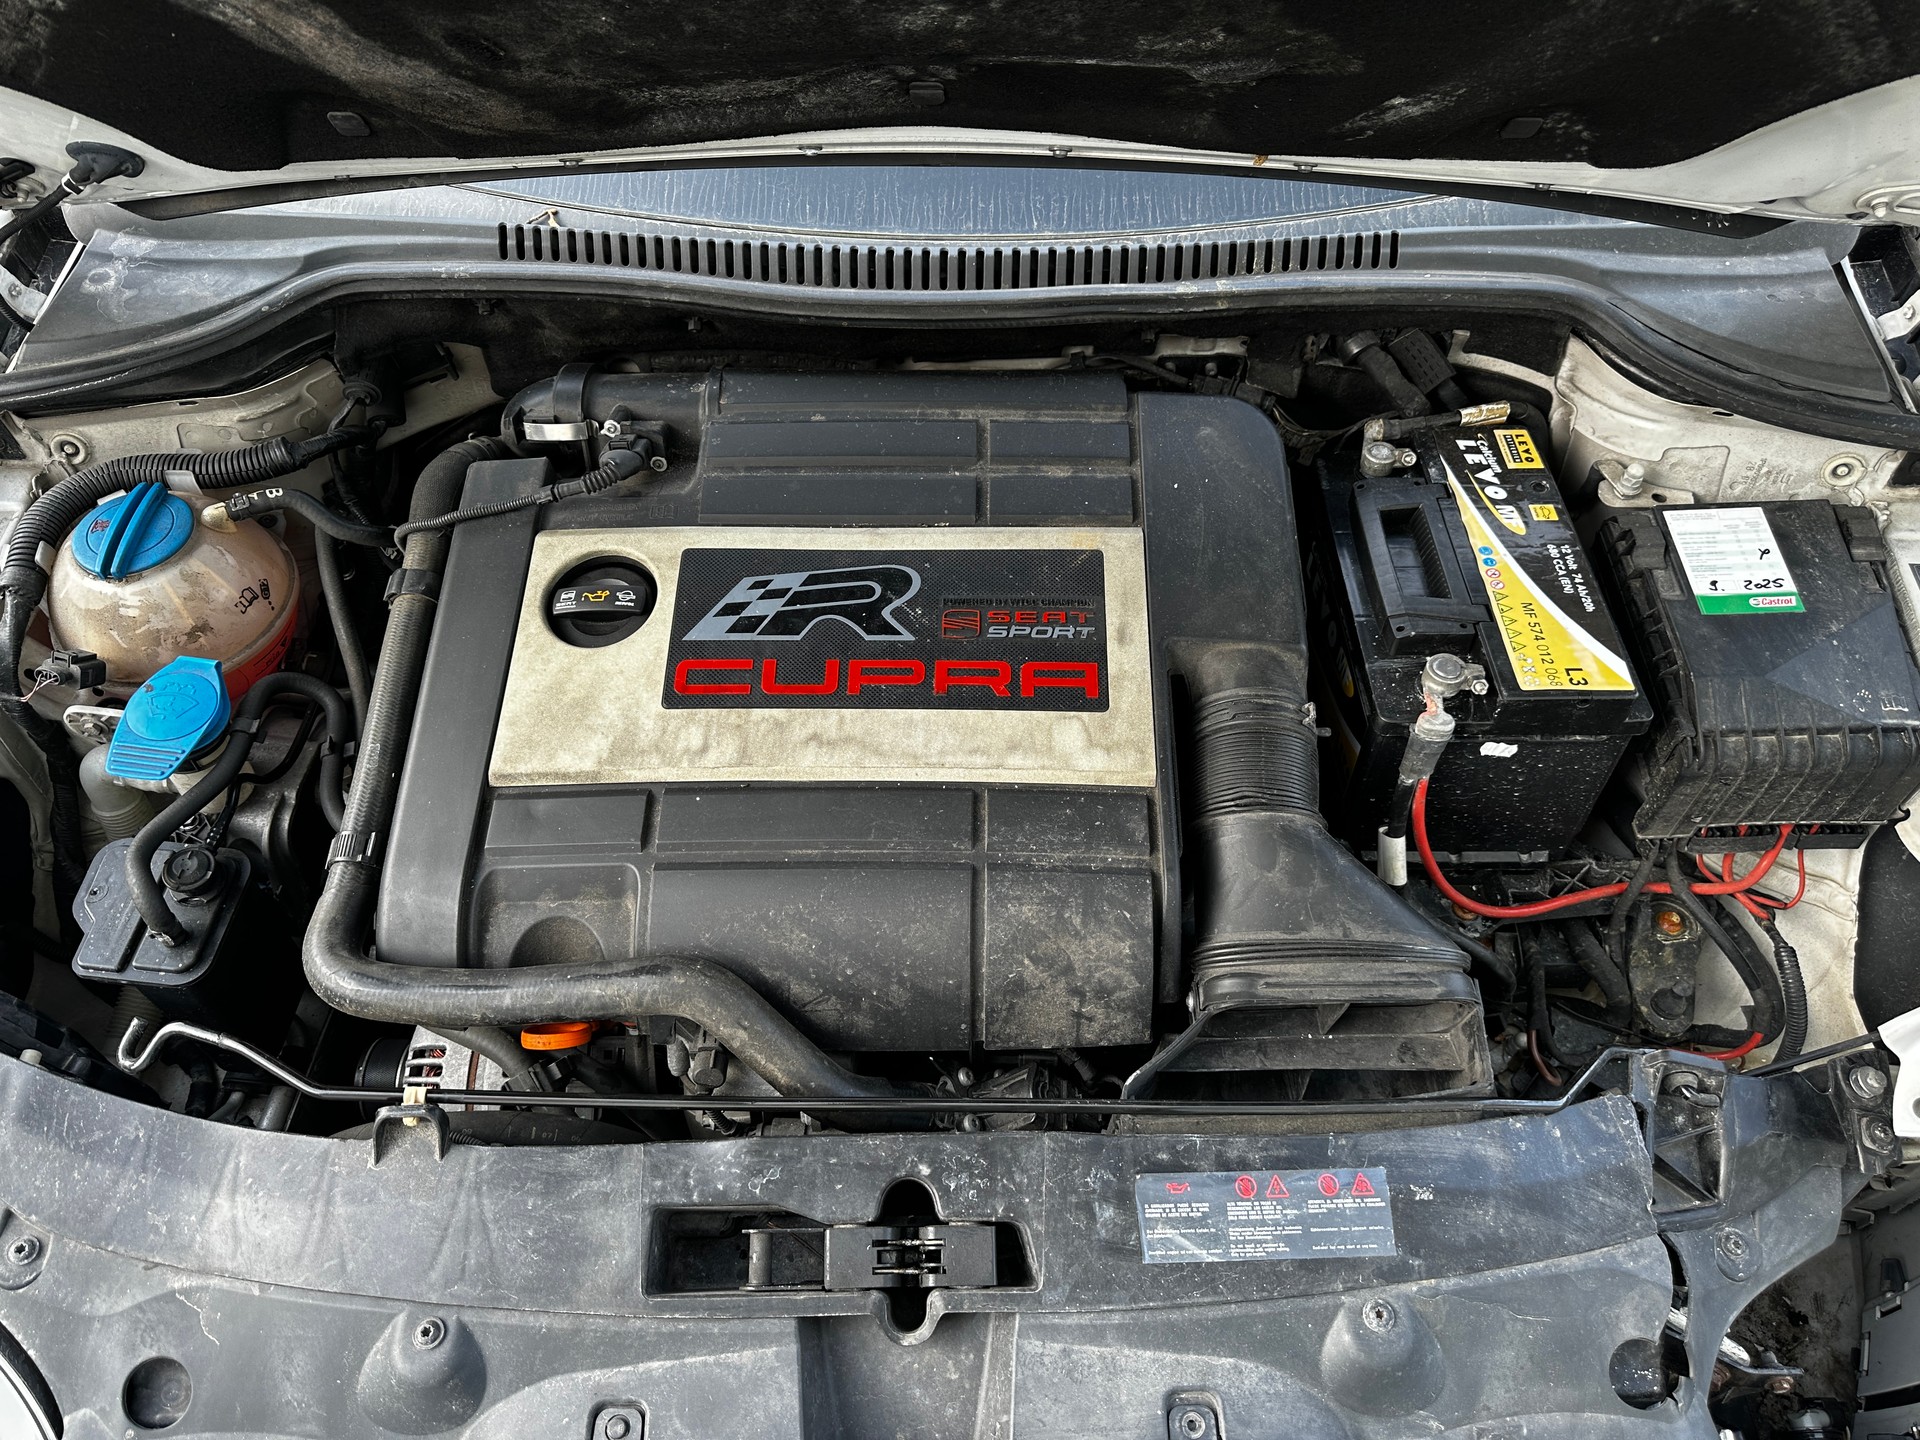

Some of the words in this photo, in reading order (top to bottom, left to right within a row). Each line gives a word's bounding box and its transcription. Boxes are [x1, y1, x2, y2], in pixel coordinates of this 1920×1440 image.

[1476, 440, 1503, 473] Calcium
[1514, 434, 1535, 463] LEVO
[1455, 438, 1508, 500] LEVO
[1495, 505, 1522, 529] MF
[1546, 544, 1559, 558] 680
[1560, 544, 1573, 554] 12
[1552, 559, 1565, 576] CCA
[1565, 554, 1577, 570] Volt
[1556, 576, 1574, 594] (EN)
[1571, 573, 1583, 584] 74
[1744, 578, 1784, 590] 2025
[1576, 584, 1595, 612] Ah/20h
[1761, 597, 1794, 606] Castrol
[987, 610, 1095, 624] SEAT
[1521, 602, 1537, 619] MF
[987, 625, 1096, 639] SPORT
[1528, 622, 1543, 641] 574
[1536, 644, 1555, 665] 012
[673, 658, 1100, 698] CUPRA
[1542, 667, 1563, 687] 068
[1564, 667, 1589, 687] L3
